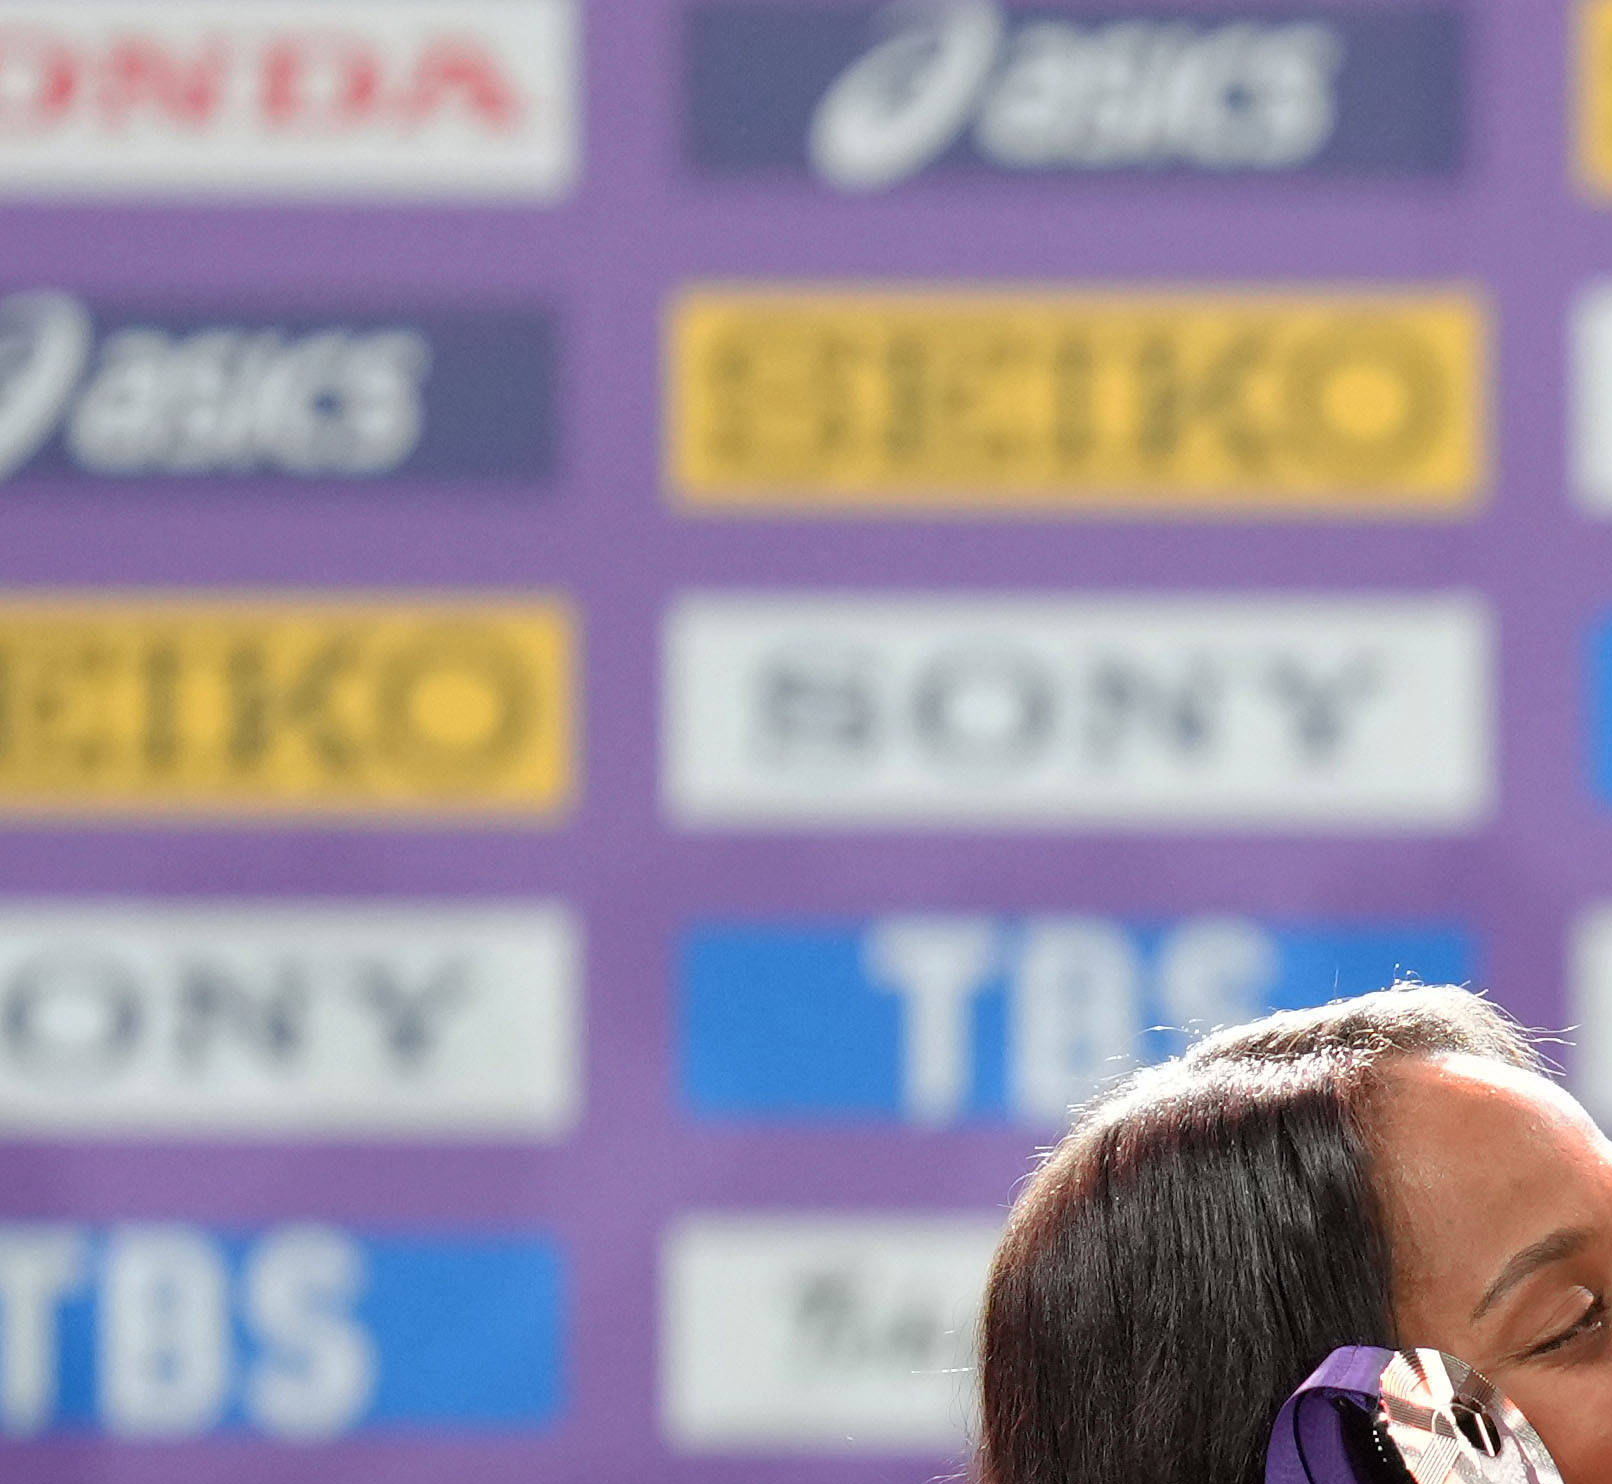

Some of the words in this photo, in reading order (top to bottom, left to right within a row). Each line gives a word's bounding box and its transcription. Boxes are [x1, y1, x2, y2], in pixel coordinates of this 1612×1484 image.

[975, 15, 1337, 160] asics
[71, 325, 433, 470] asics
[705, 309, 1464, 471] SEIKO
[751, 647, 1385, 766] SONY
